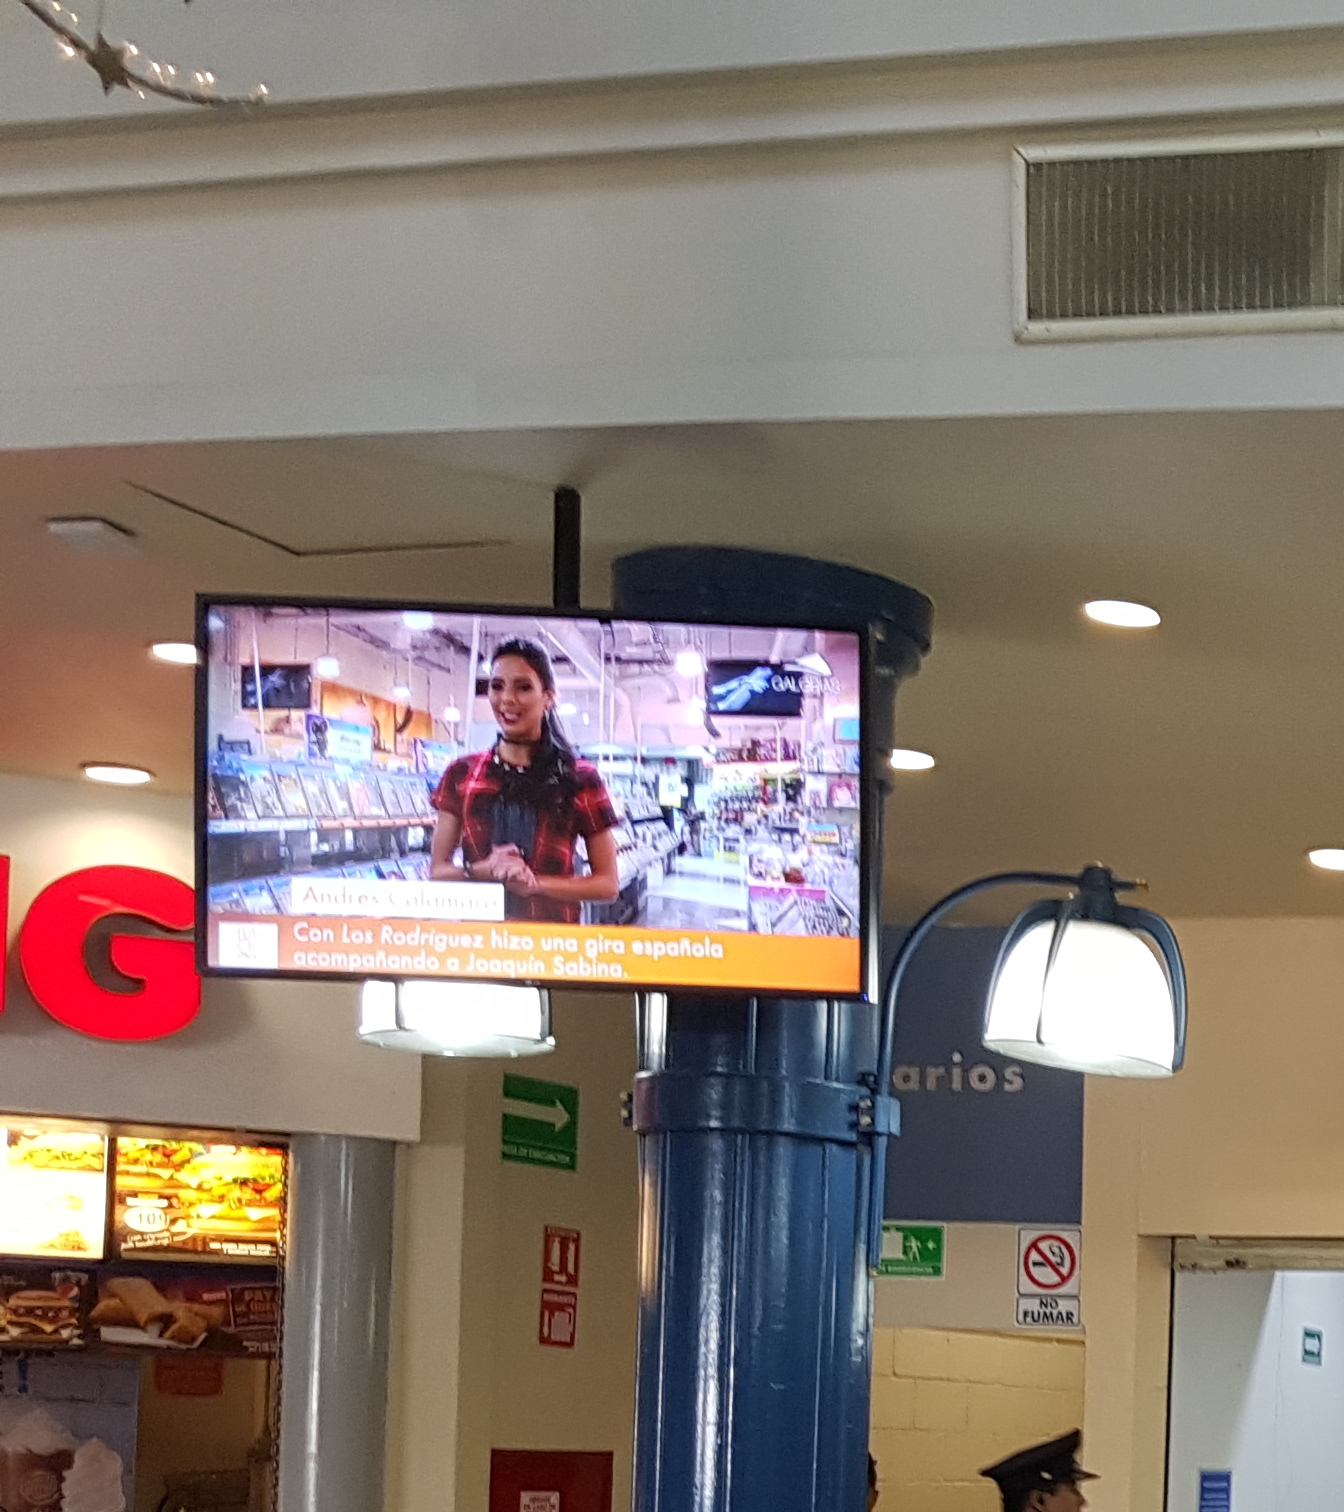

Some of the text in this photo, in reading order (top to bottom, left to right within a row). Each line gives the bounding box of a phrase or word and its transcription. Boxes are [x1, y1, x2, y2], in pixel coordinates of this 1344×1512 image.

[0, 855, 203, 1042] G
[293, 923, 334, 943] Con
[343, 925, 373, 944] Los
[491, 929, 533, 951] hizo
[541, 937, 578, 952] una
[585, 932, 625, 958] gira
[632, 936, 724, 960] española
[293, 949, 629, 979] acompañando a Joaquín Sabina.
[892, 1050, 1025, 1092] arios
[1022, 1310, 1075, 1325] FUMAR
[1039, 1297, 1059, 1310] NO
